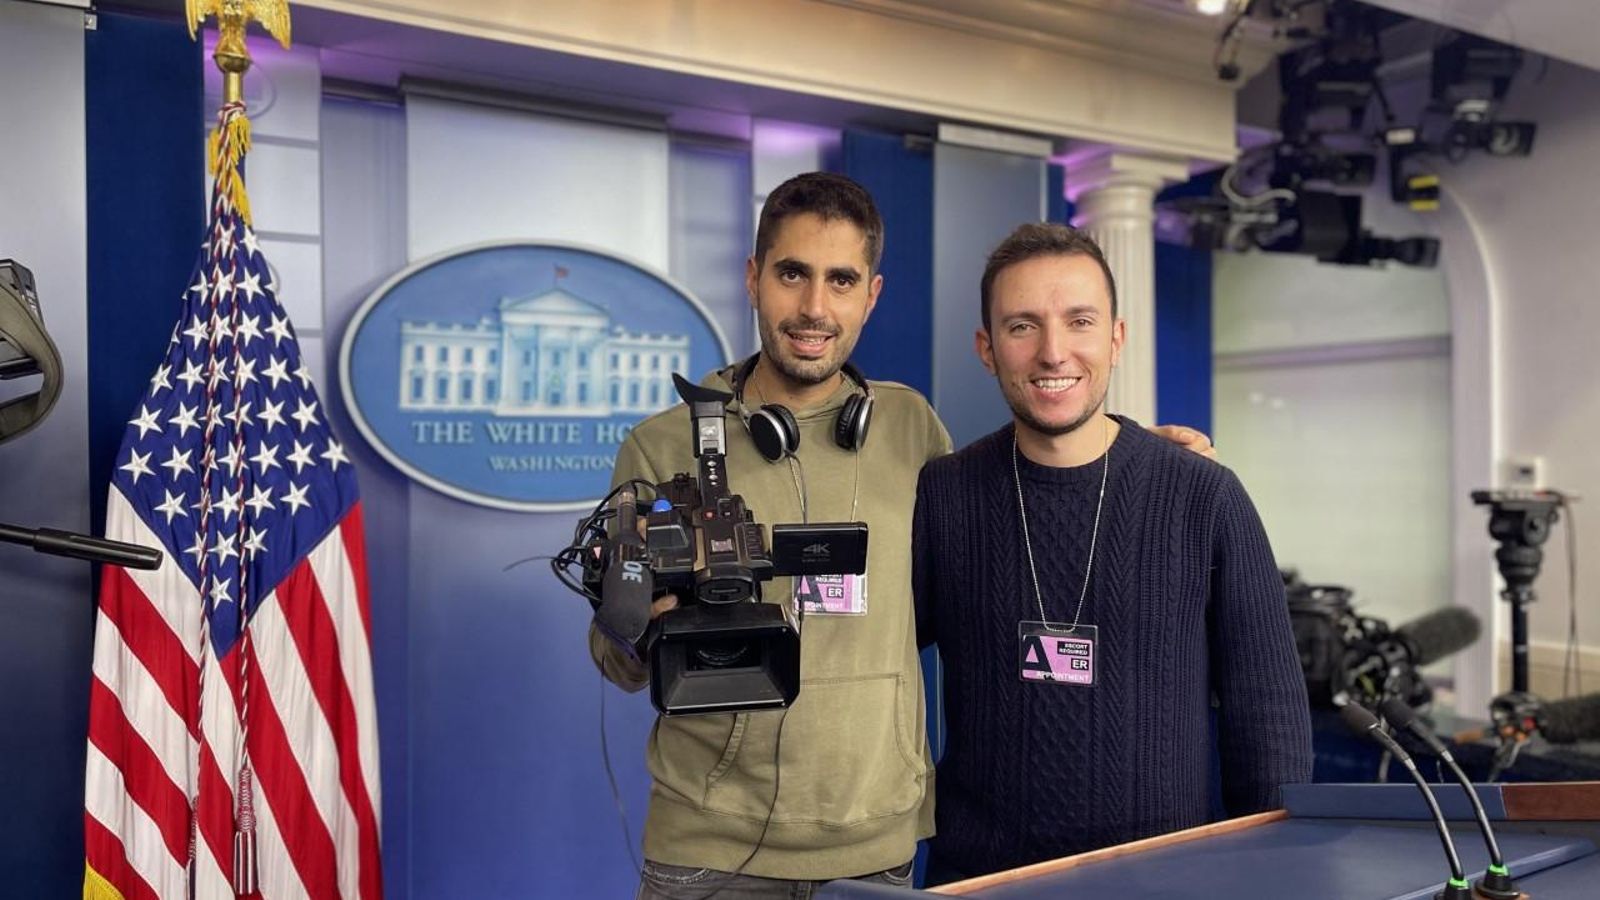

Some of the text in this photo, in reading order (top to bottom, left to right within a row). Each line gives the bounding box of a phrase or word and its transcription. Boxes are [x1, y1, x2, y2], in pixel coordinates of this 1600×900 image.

[413, 421, 473, 443] THE
[487, 421, 582, 443] WHITE
[490, 454, 616, 471] WASHINGTON
[803, 543, 831, 553] 4K
[828, 588, 843, 597] ER
[1072, 659, 1088, 669] ER
